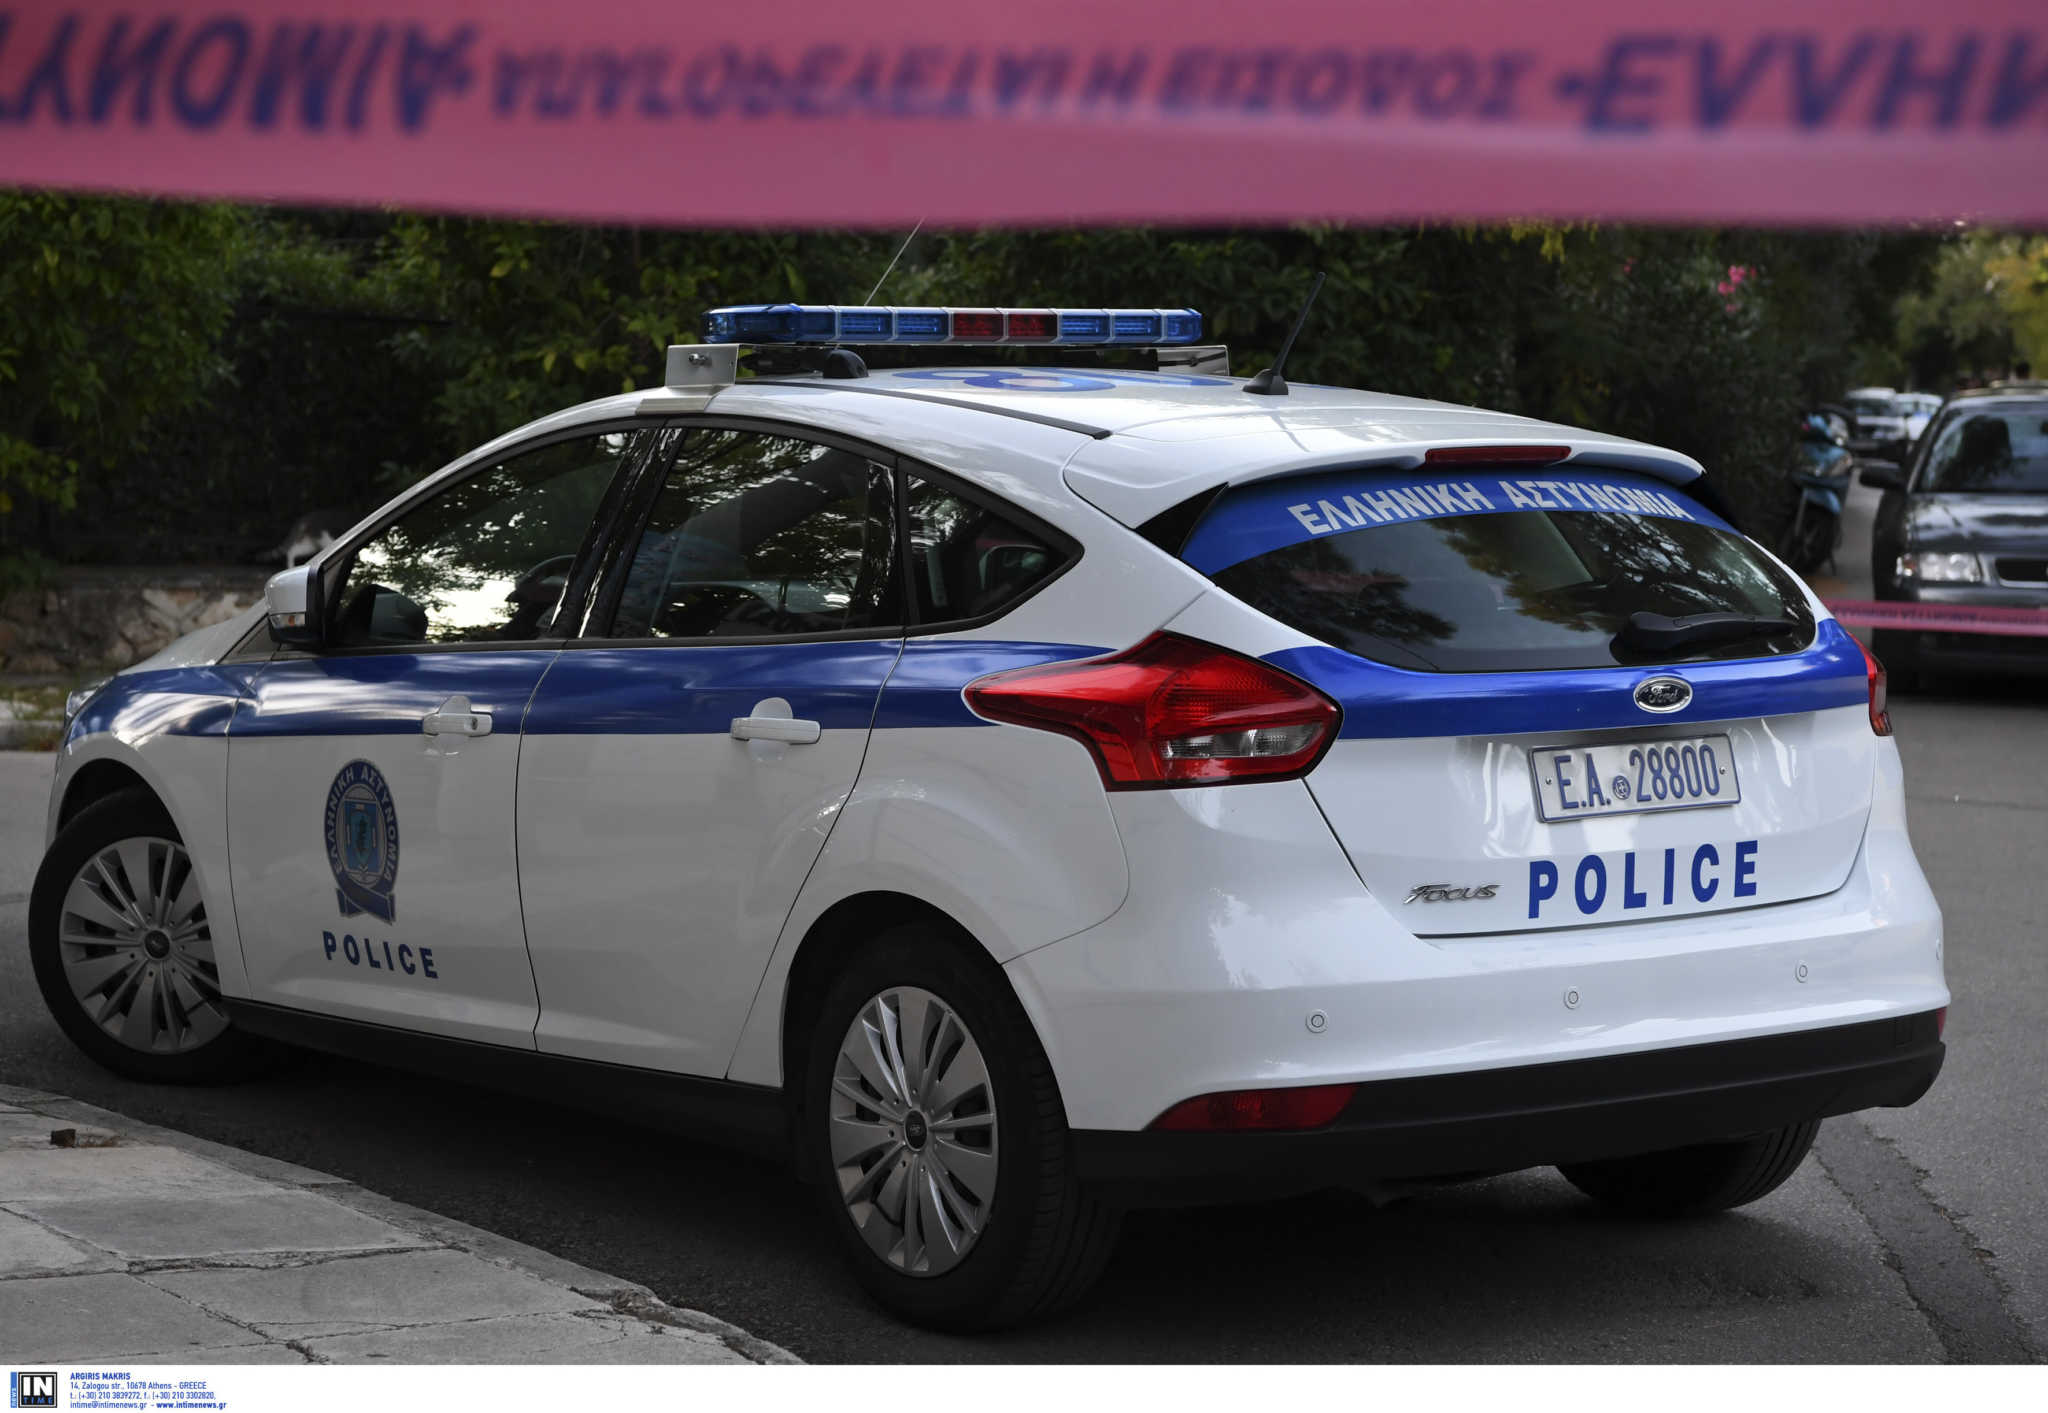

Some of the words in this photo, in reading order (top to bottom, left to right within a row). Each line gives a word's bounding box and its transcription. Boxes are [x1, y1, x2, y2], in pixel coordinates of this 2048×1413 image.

[1288, 482, 1496, 535] ΕΛΛΗΝΙΚΗ
[1498, 479, 1697, 521] ΑΣΤΥΝΟΜΙΑ
[1629, 743, 1721, 803] 28800
[326, 766, 355, 875] ΕΛΛΗΝΙΚΗ
[361, 765, 397, 882] ΑΣΤΥΝΟΜΙΑ
[1528, 840, 1759, 920] POLICE
[322, 930, 439, 980] POLICE
